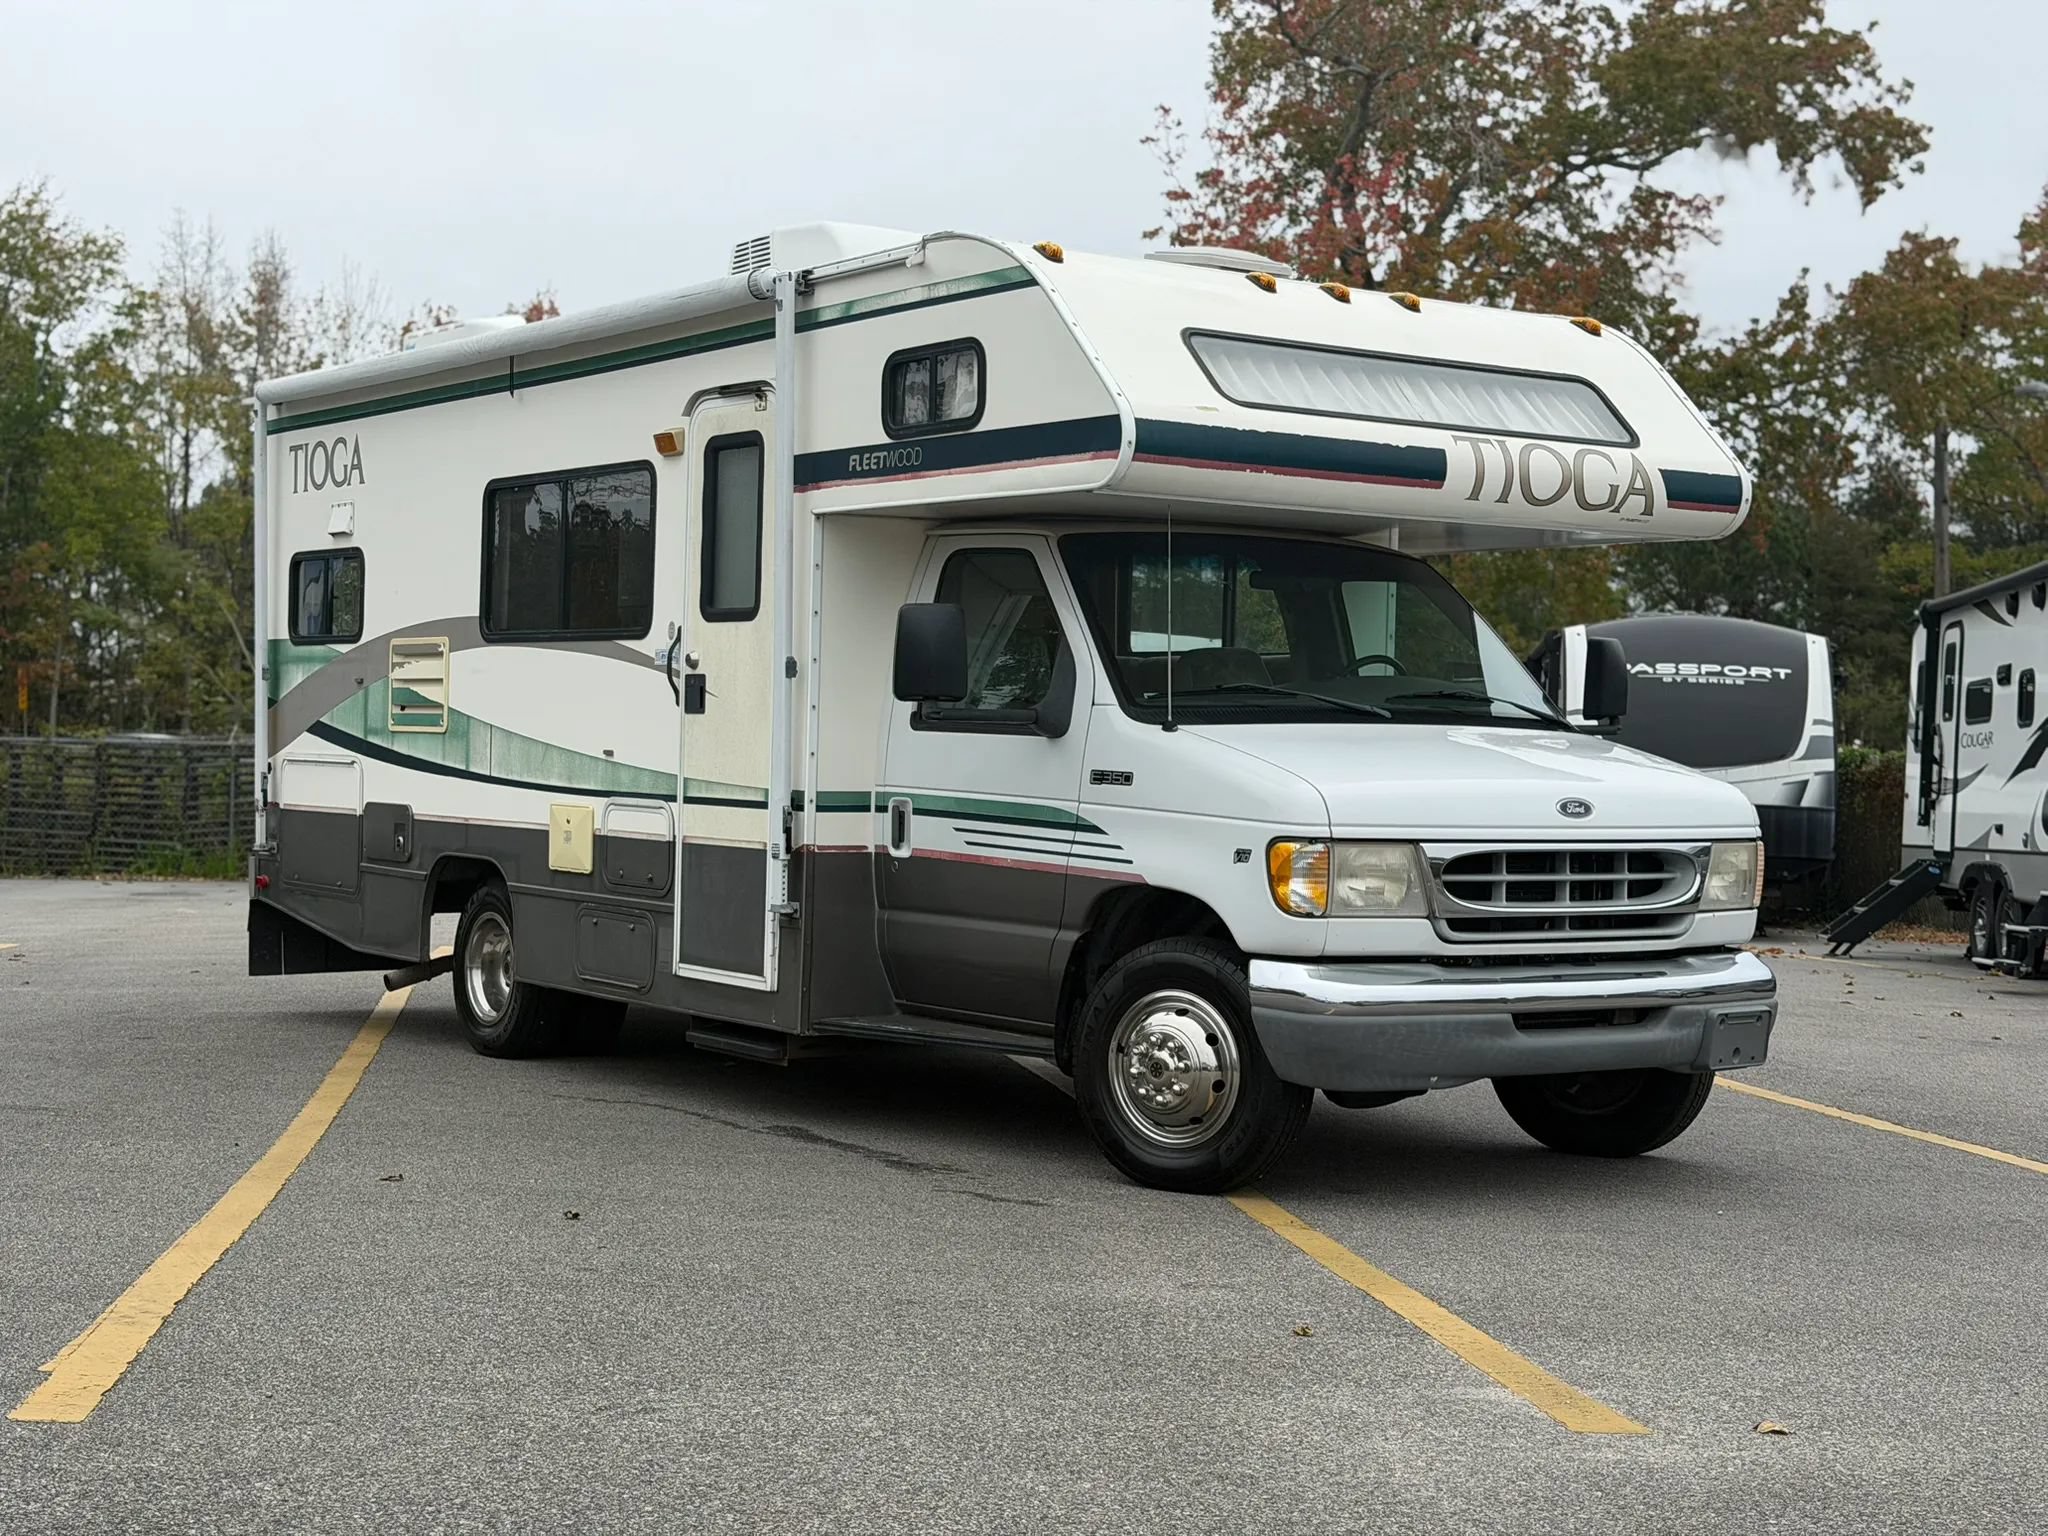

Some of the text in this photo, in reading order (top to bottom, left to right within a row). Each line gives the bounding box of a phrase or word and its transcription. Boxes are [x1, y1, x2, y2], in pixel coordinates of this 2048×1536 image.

[289, 432, 365, 494] TIOGA
[849, 447, 922, 471] FLEETWOOD
[1451, 434, 1654, 516] TIOGA
[1626, 663, 1792, 680] ASSPORT
[1687, 677, 1745, 685] SERIES
[1961, 731, 1993, 749] COUGAR
[1090, 770, 1133, 786] E350
[1566, 802, 1585, 813] Ford
[1233, 853, 1250, 864] V10
